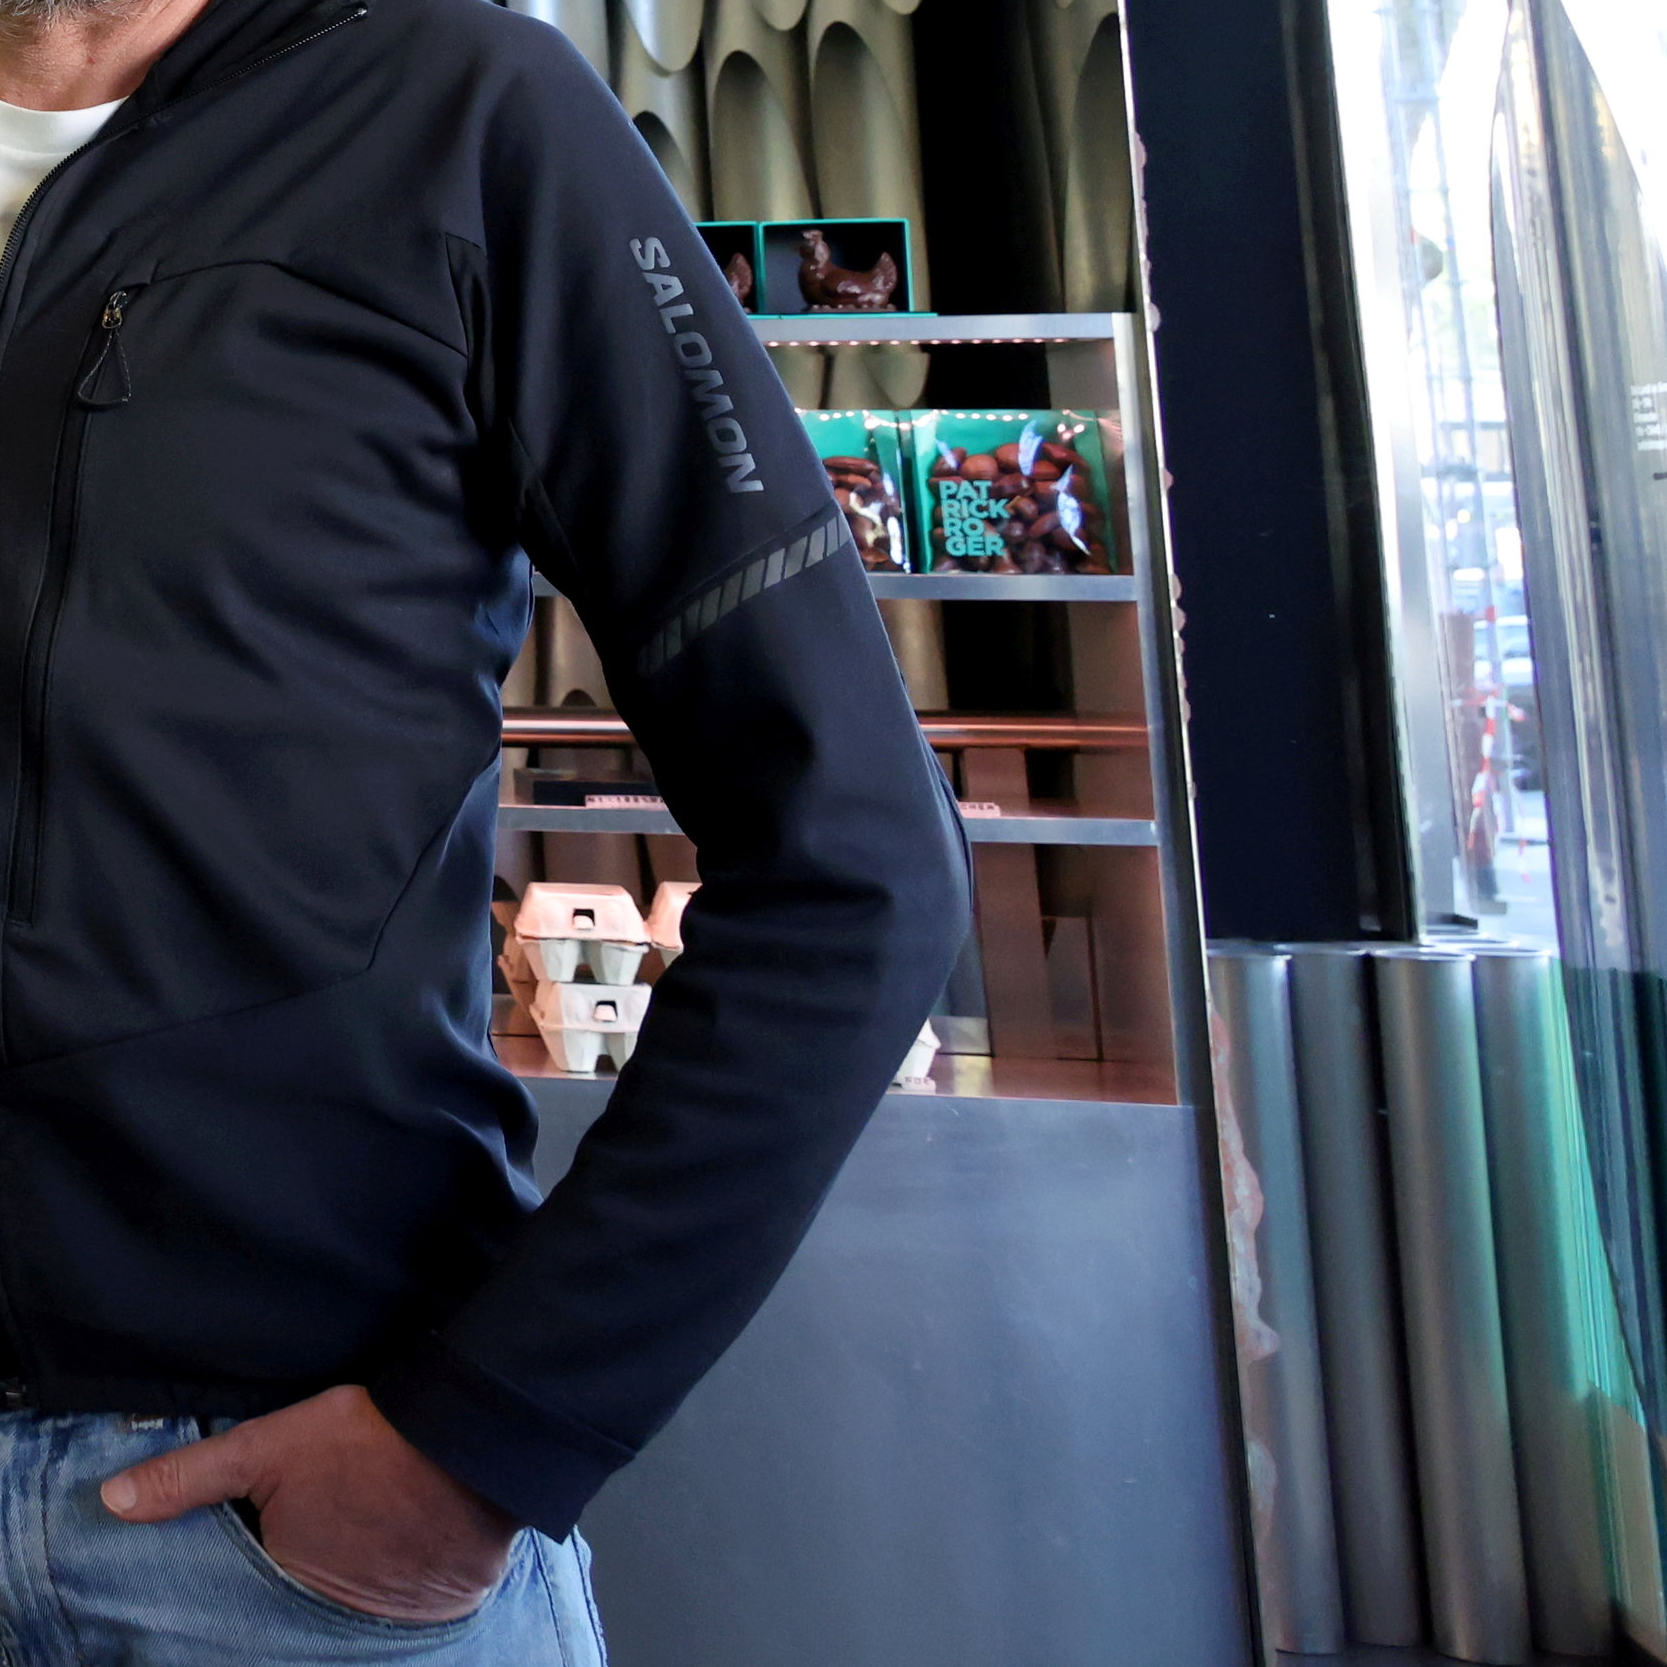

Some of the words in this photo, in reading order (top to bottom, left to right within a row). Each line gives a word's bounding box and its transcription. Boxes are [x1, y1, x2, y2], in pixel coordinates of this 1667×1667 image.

[628, 236, 764, 493] SALOMON
[939, 480, 992, 501] PAT
[941, 498, 1011, 519] RICK
[943, 517, 985, 538] RO
[945, 535, 1005, 556] GER
